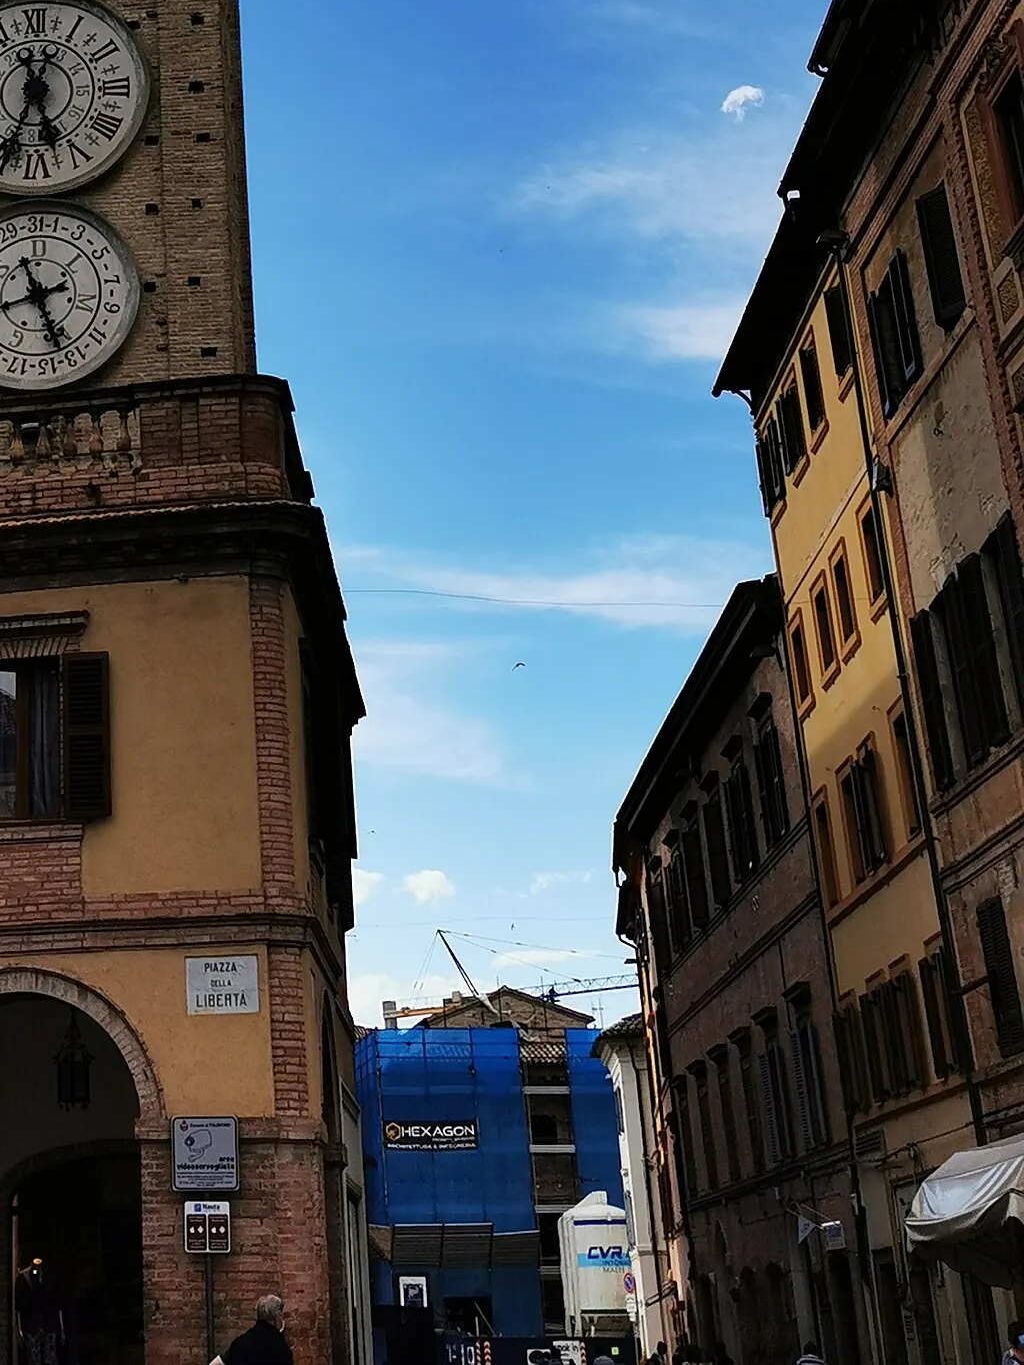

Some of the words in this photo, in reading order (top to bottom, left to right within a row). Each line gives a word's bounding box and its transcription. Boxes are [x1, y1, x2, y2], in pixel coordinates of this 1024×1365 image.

[21, 8, 48, 35] XII
[66, 15, 85, 40] I
[89, 38, 120, 63] II
[68, 62, 85, 76] 14
[75, 84, 90, 97] 15
[102, 75, 130, 98] III
[68, 104, 85, 121] 16
[89, 111, 124, 142] IIII
[67, 142, 93, 170] V
[22, 153, 52, 180] VI
[70, 224, 86, 241] 3
[30, 239, 46, 258] D
[91, 246, 111, 260] 5
[64, 252, 83, 274] L
[103, 274, 121, 285] 7
[75, 292, 97, 314] M
[103, 301, 120, 314] 9
[8, 329, 24, 348] G
[87, 326, 107, 346] 11
[6, 355, 28, 375] 17
[64, 345, 86, 367] 13
[37, 357, 58, 376] 15
[204, 961, 237, 973] PIAZZA
[210, 979, 232, 988] DELLA
[196, 989, 247, 1008] LIBERTÀ
[401, 1125, 475, 1137] HEXAGON
[587, 1246, 623, 1259] CVR
